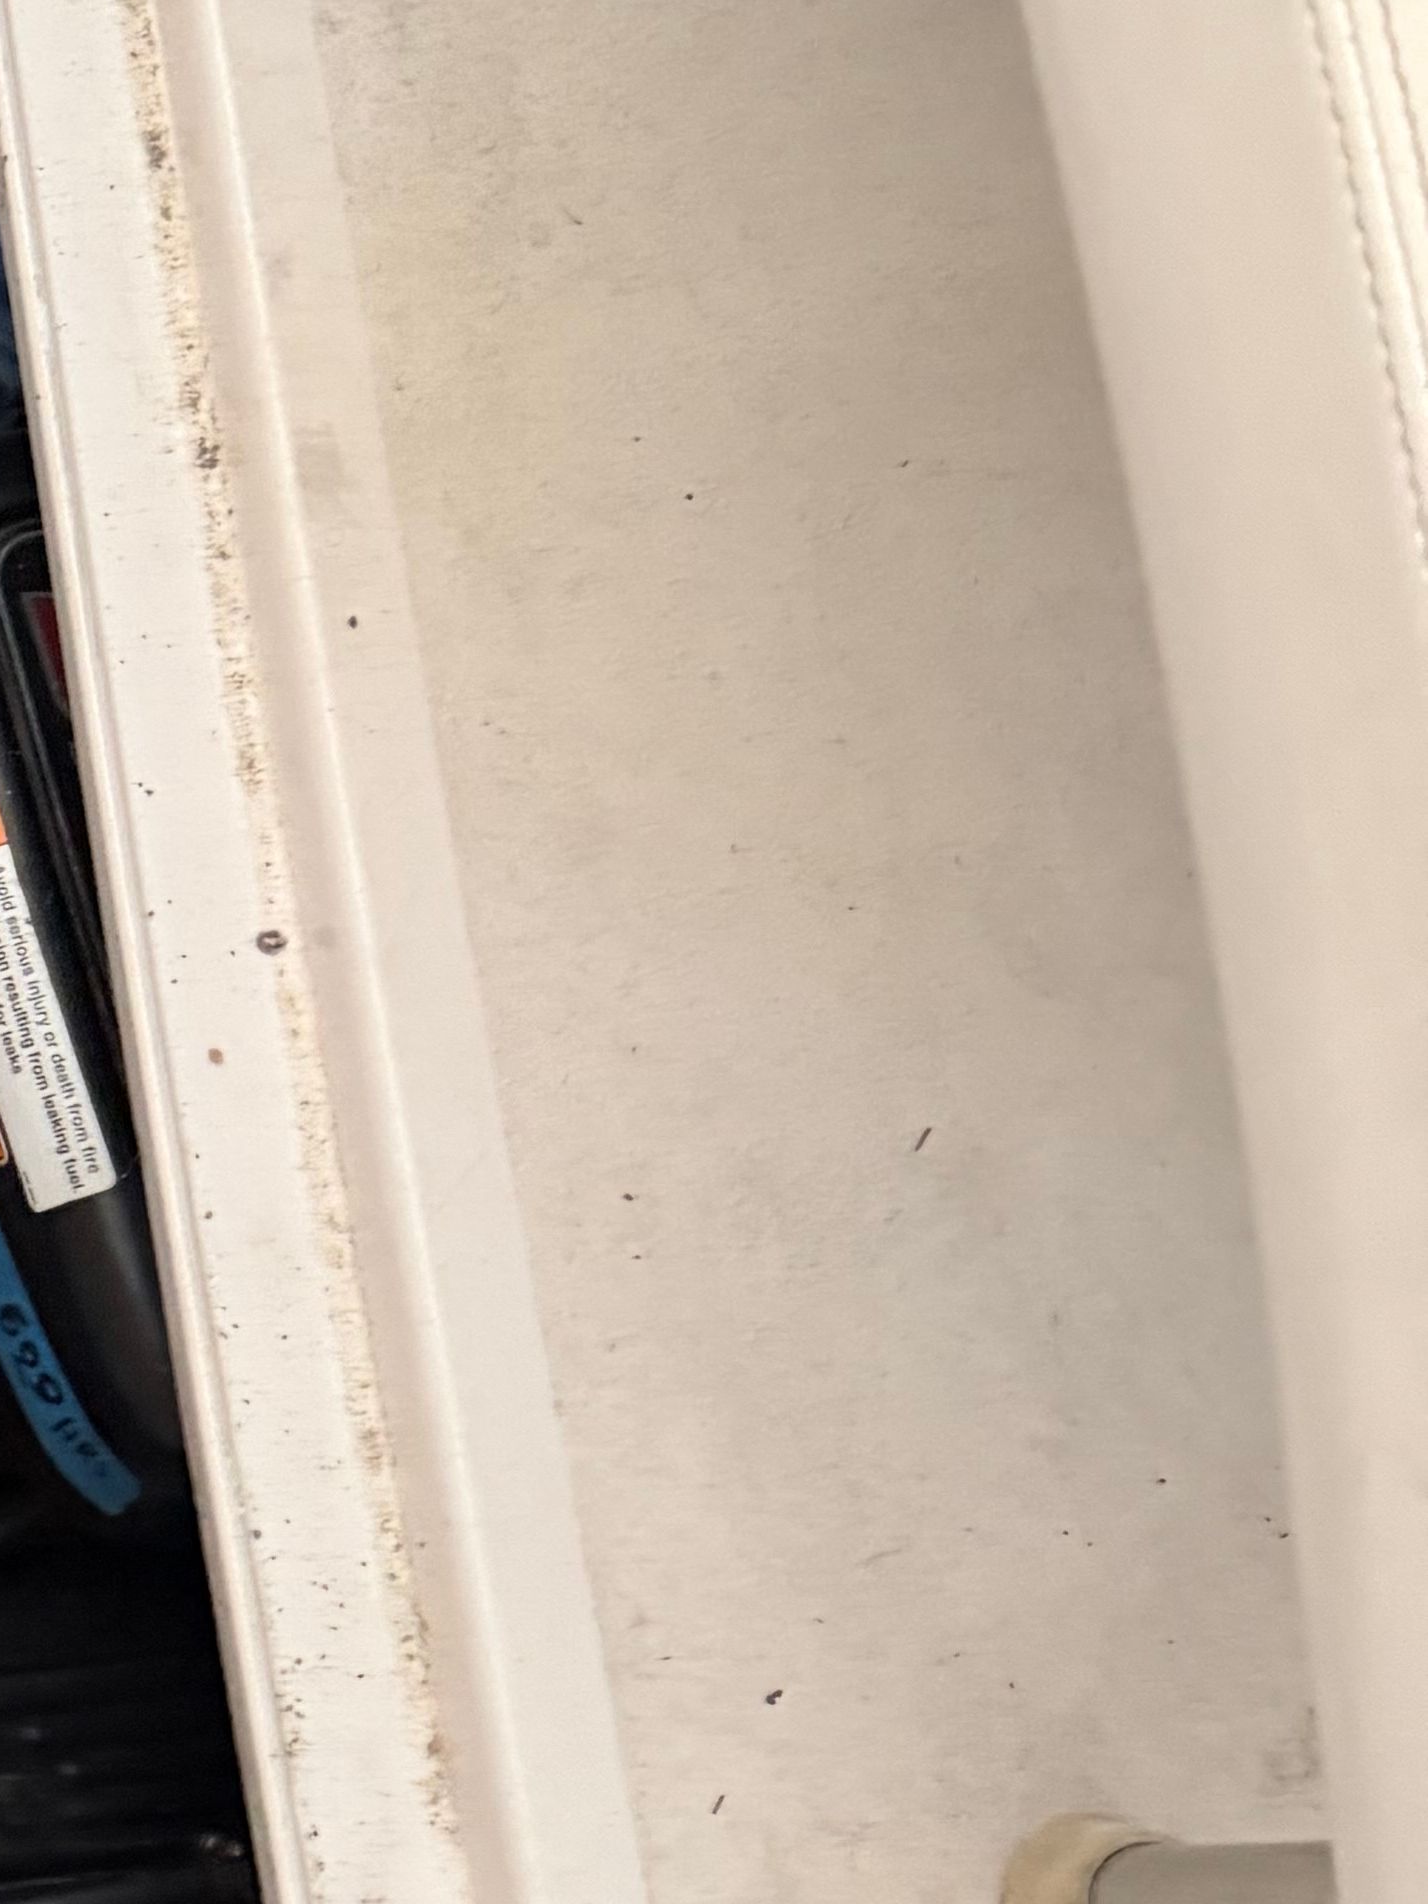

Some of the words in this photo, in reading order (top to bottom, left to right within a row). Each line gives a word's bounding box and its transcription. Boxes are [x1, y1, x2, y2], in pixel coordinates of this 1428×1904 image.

[5, 914, 37, 976] serious
[0, 973, 38, 1050] resulting
[22, 978, 55, 1029] injury
[42, 1030, 58, 1048] or
[27, 1050, 52, 1091] from
[49, 1050, 78, 1100] death
[39, 1092, 73, 1156] leaking
[66, 1101, 92, 1143] from
[62, 1156, 86, 1194] fuel.
[80, 1144, 102, 1174] fire
